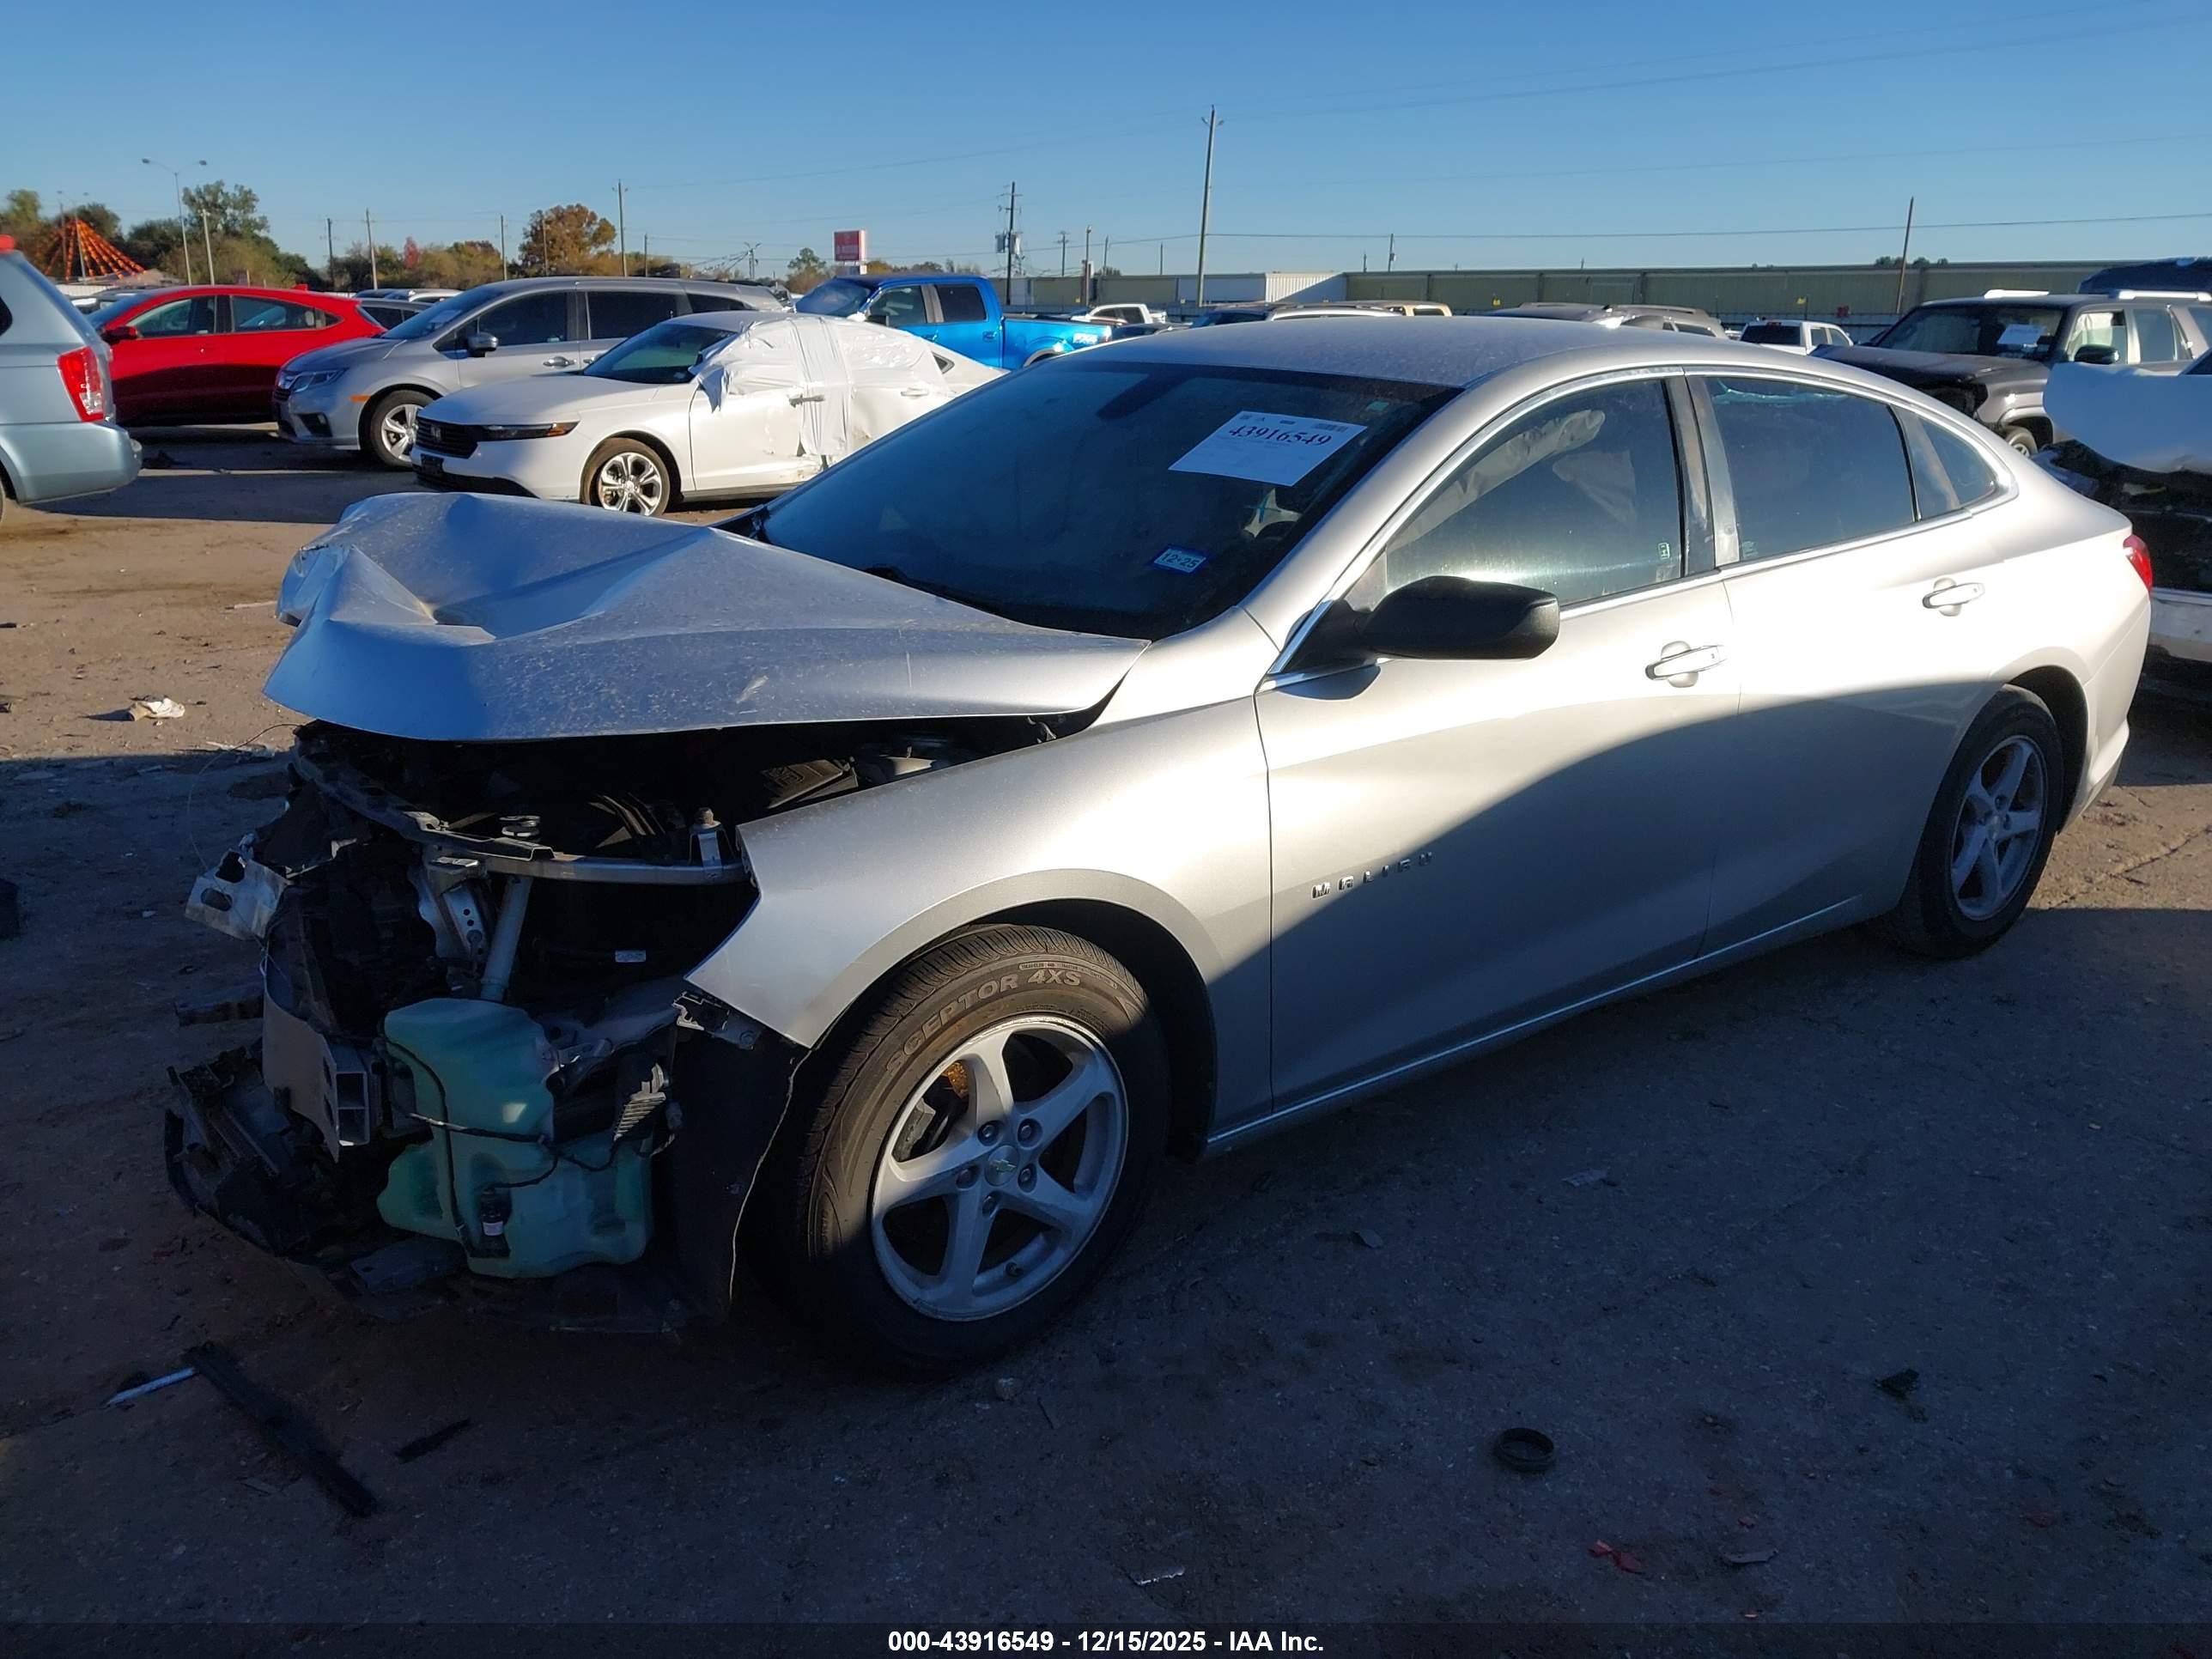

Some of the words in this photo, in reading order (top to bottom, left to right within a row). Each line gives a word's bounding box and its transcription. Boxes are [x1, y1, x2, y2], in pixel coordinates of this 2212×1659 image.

[1228, 425, 1333, 446] 43916549
[886, 973, 1020, 1073] SCEPTOR
[1027, 968, 1082, 987] 4XS
